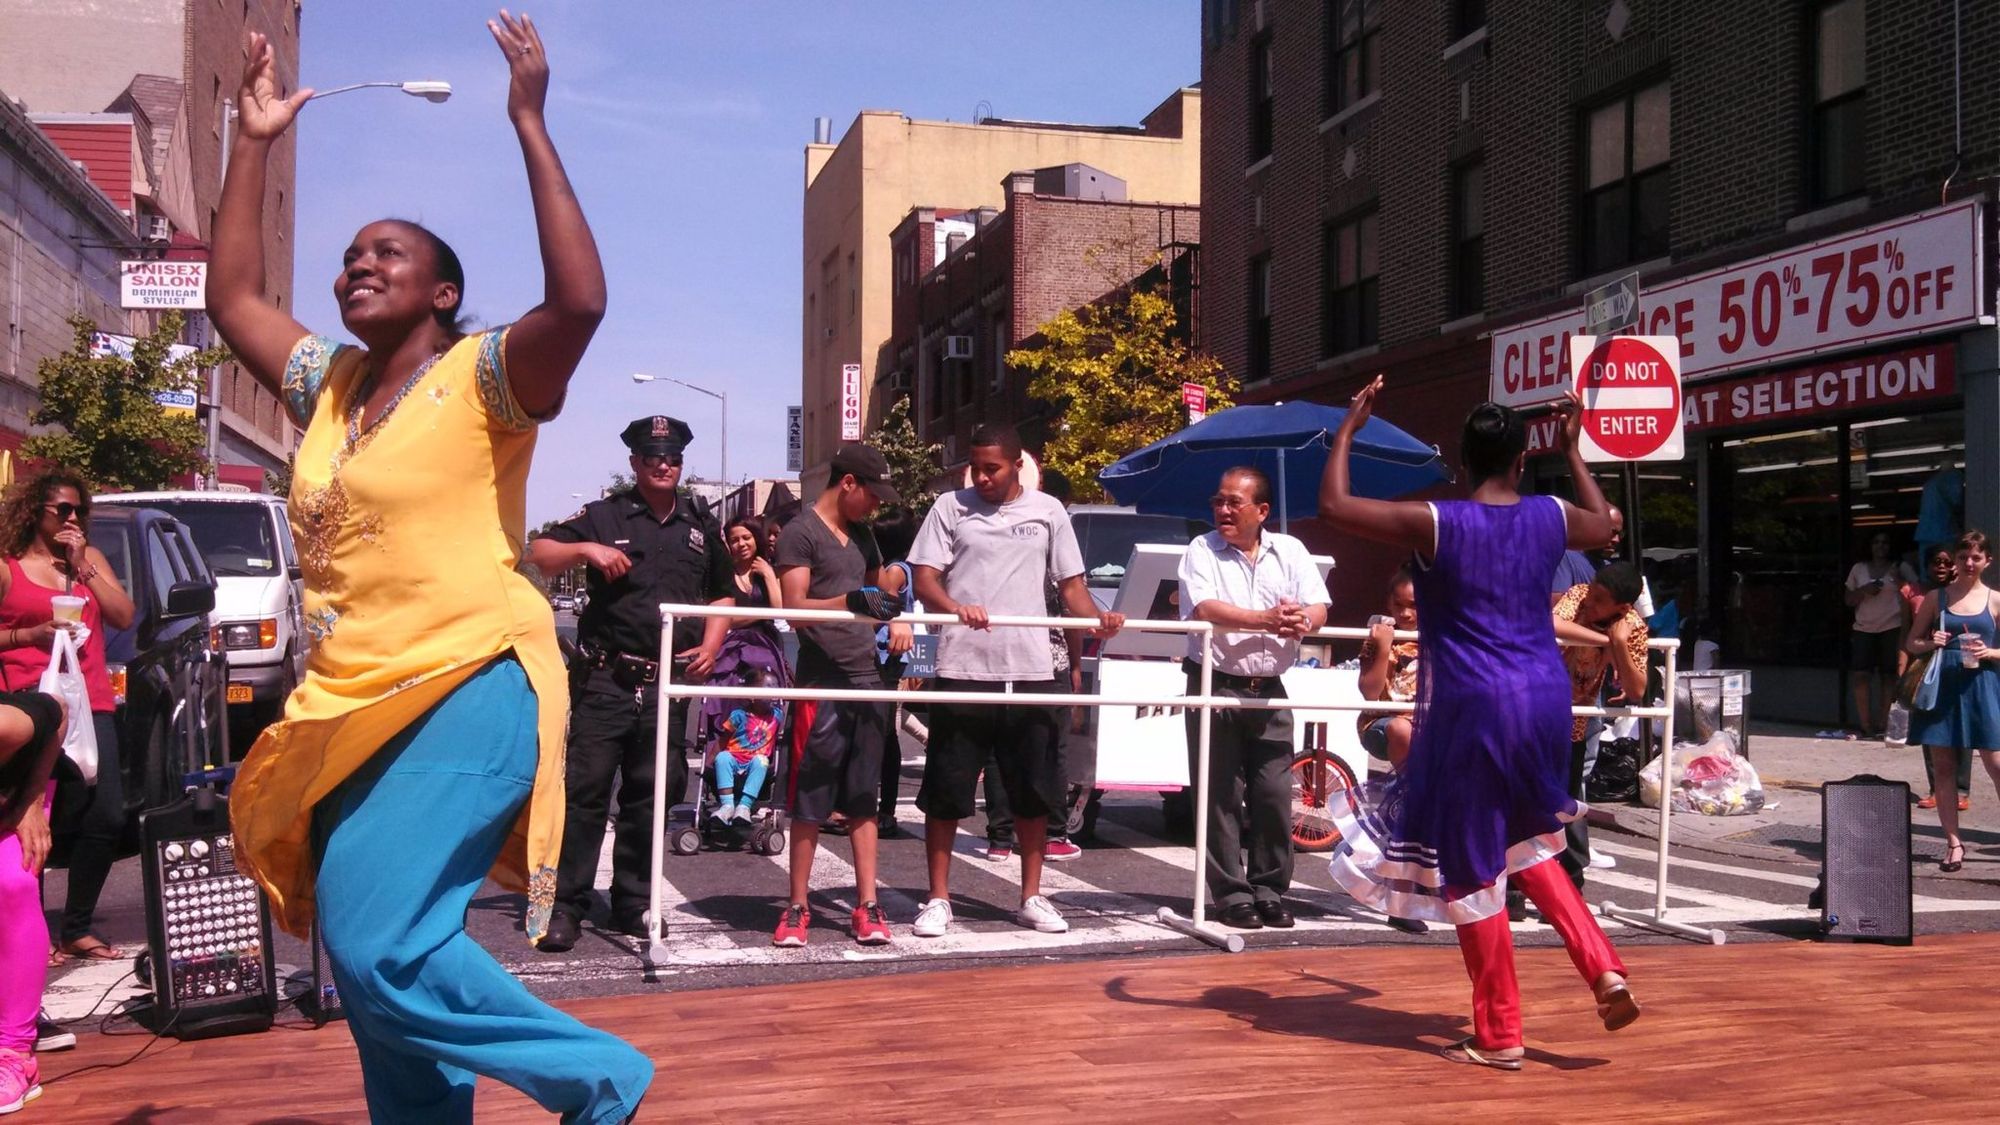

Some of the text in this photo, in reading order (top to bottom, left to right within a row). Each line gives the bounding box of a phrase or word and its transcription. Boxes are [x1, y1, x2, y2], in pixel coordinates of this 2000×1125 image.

[127, 264, 201, 275] UNISEX
[131, 276, 199, 287] SALON
[132, 289, 197, 297] DOMINICAN
[143, 297, 186, 305] STYLIST
[1887, 265, 1954, 320] OFF
[1612, 292, 1630, 316] WAY
[1593, 362, 1660, 381] DO NOT
[845, 373, 858, 419] LUGO
[1731, 354, 1936, 420] SELECTION
[789, 416, 801, 449] TAXES
[1600, 416, 1659, 435] ENTER
